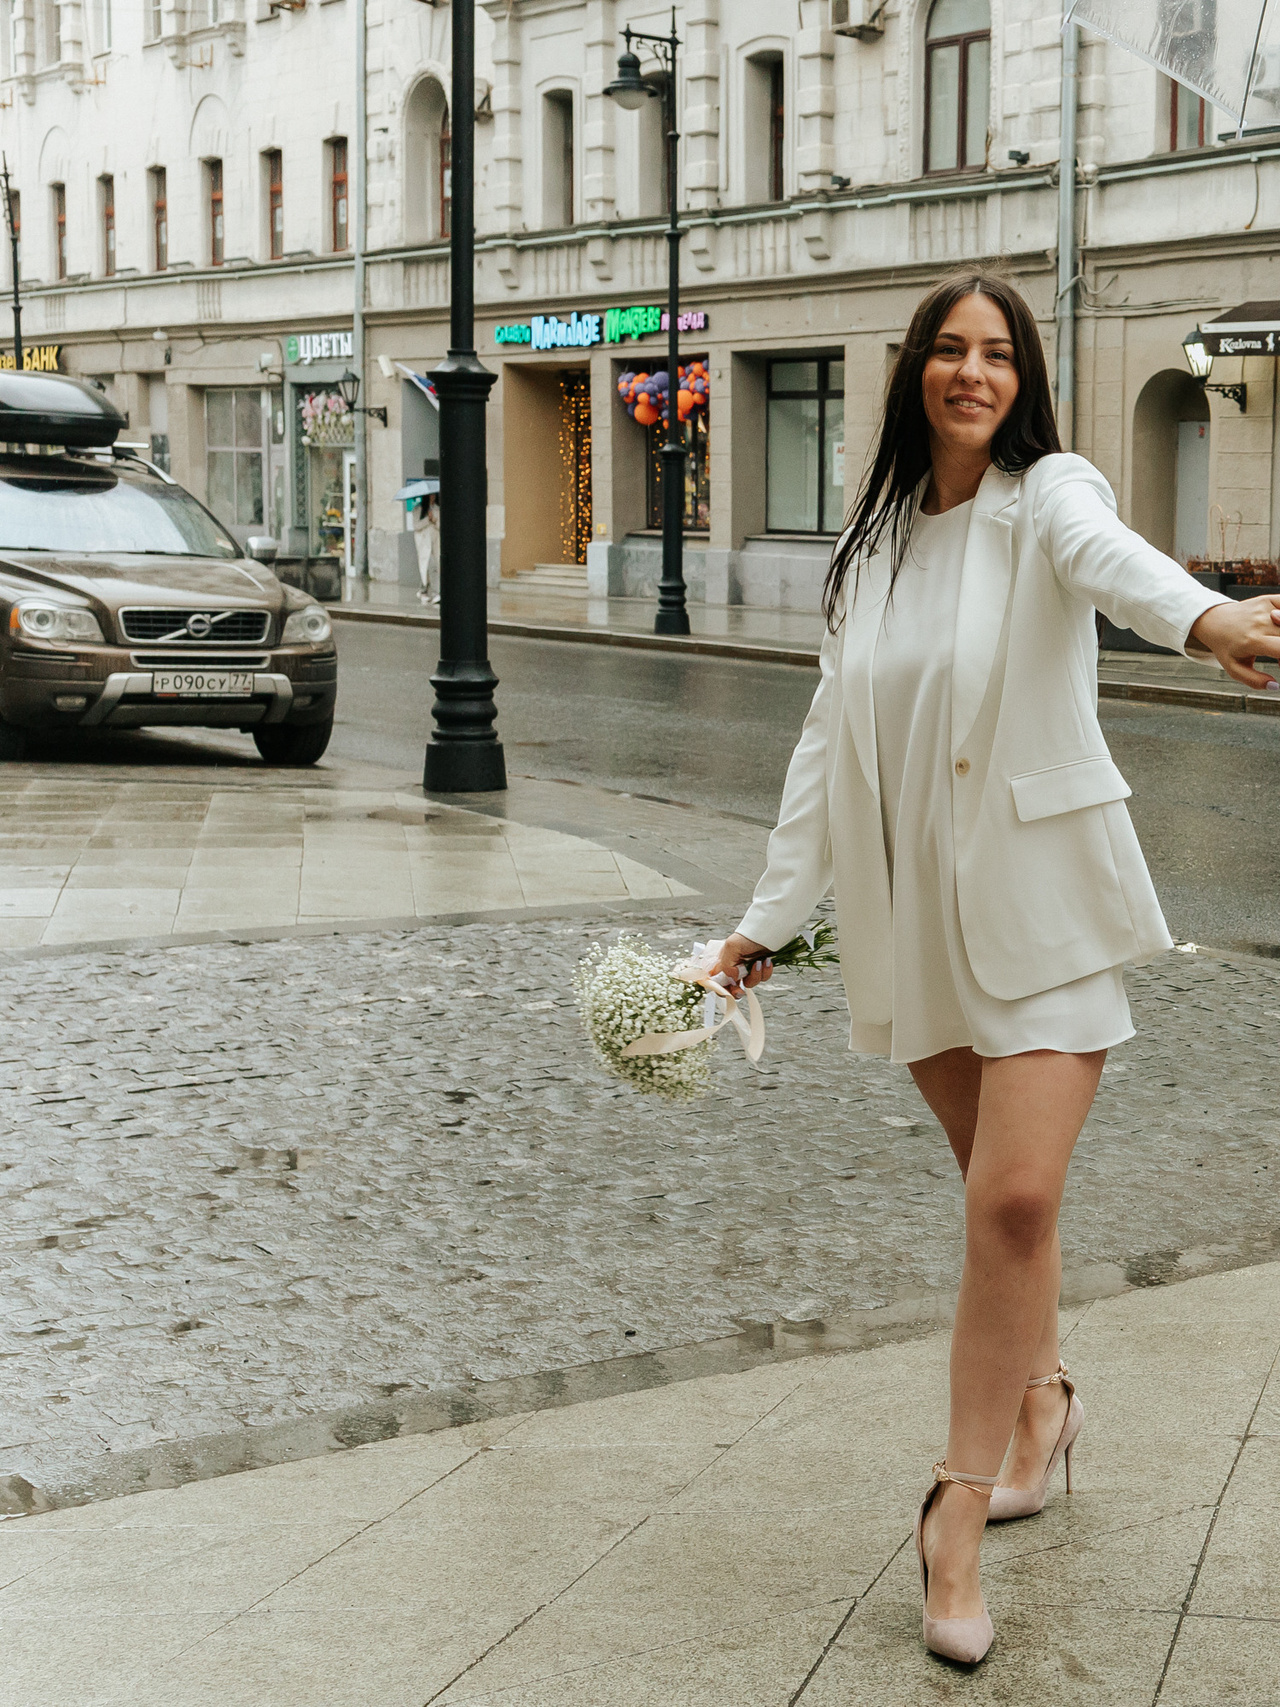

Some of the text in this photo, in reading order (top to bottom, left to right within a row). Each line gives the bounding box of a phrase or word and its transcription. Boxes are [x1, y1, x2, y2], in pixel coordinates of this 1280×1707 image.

[23, 345, 58, 371] БАНК
[300, 332, 353, 365] ЦВЕТЫ
[1219, 337, 1262, 353] Kozlovna
